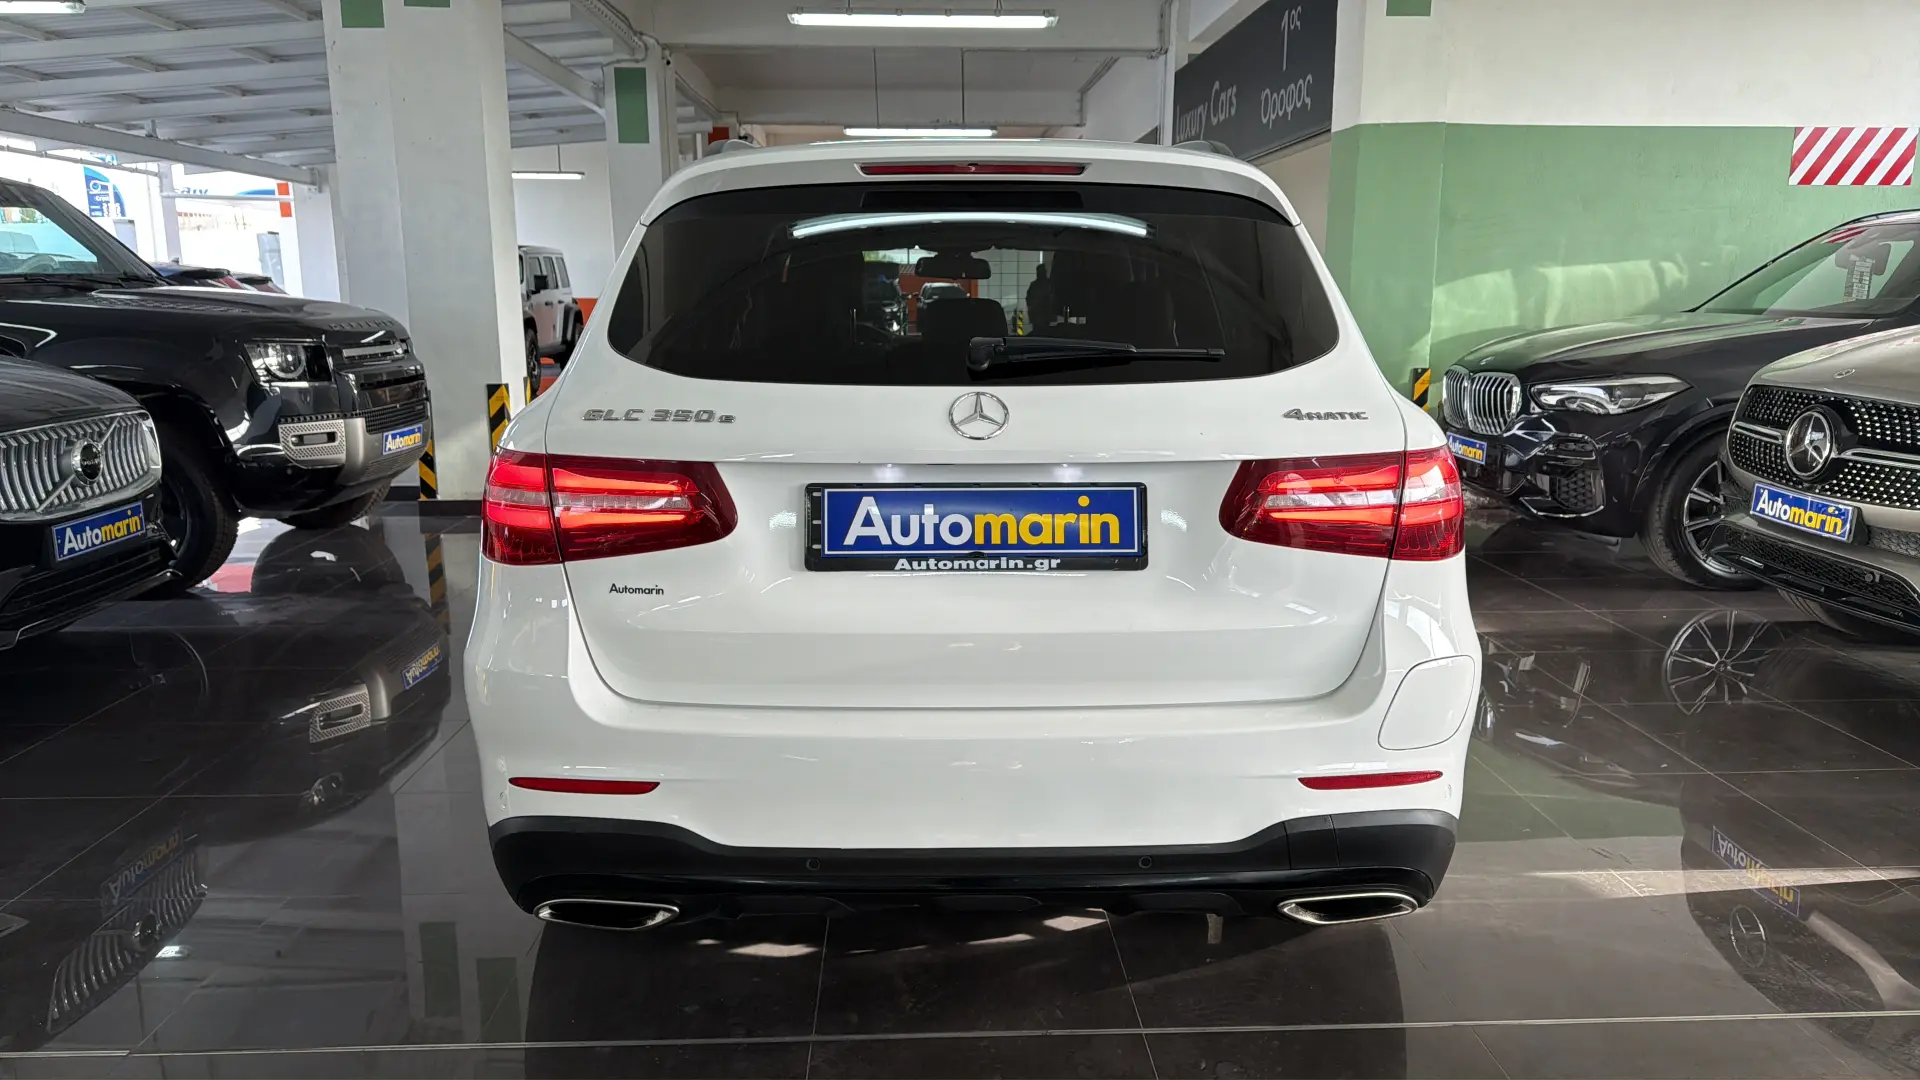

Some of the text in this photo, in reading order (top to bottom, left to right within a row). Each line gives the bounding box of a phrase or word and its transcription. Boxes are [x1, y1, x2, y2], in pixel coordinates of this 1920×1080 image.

[1175, 80, 1237, 143] Luxury Cars
[582, 408, 645, 422] GLC
[385, 426, 422, 451] Automarin
[843, 495, 1120, 546] Automarin
[1755, 489, 1843, 535] Automarin
[63, 509, 142, 555] Automarin
[894, 557, 1061, 572] Automarin.gr
[608, 582, 665, 595] Automarin
